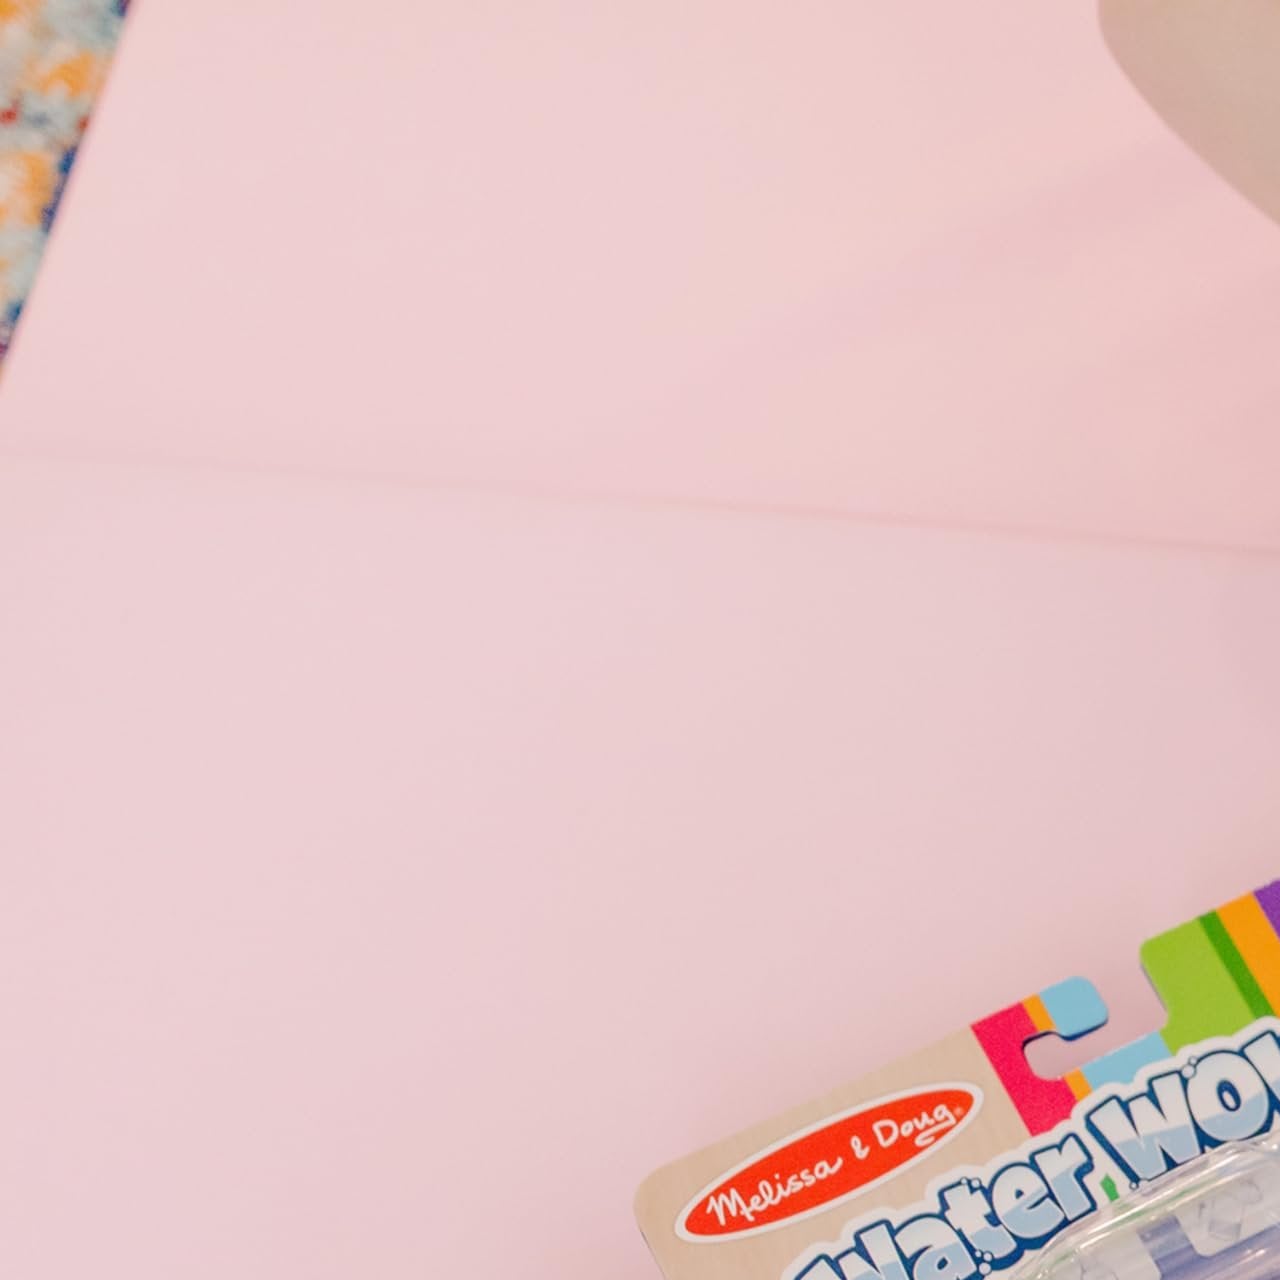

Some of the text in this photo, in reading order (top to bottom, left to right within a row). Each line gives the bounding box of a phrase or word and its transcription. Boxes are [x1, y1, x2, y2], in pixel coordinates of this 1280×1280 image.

[706, 1104, 957, 1226] Melissa & Doug
